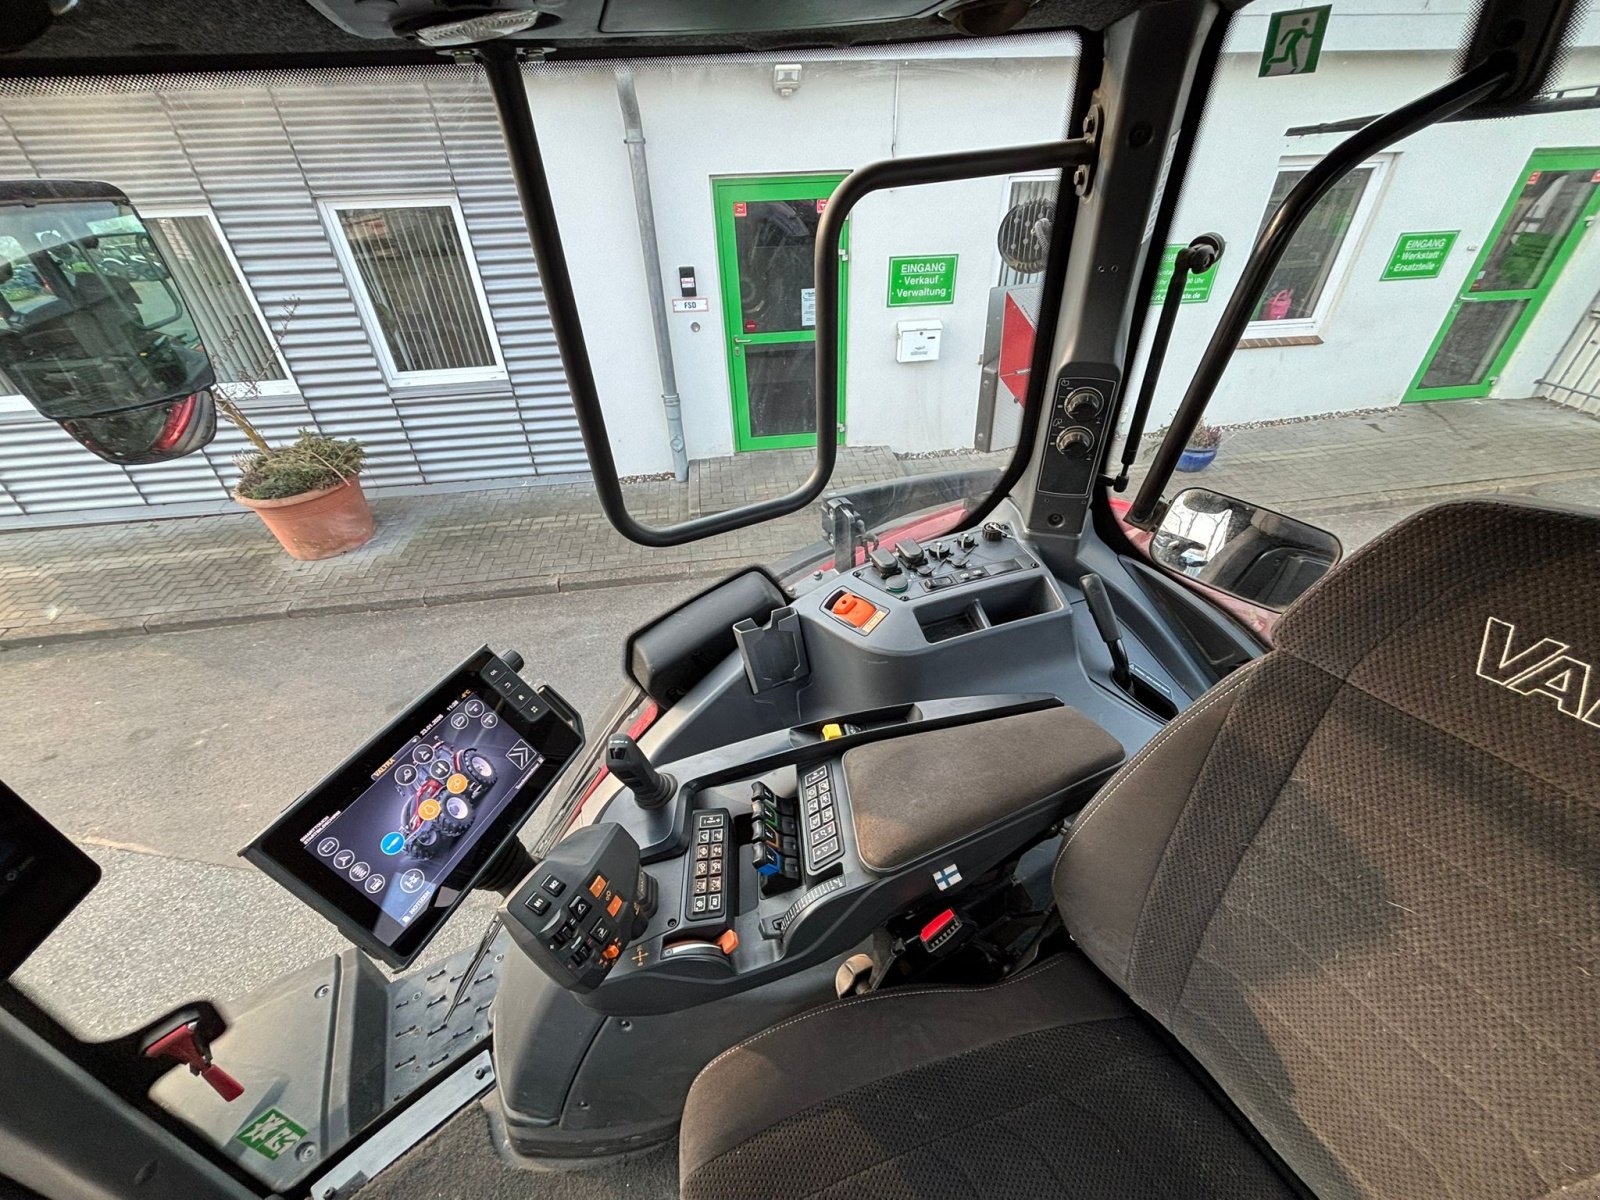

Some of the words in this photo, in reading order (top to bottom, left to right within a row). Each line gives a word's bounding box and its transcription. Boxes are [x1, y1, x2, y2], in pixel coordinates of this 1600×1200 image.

[1405, 238, 1446, 249] EINGANG
[1401, 250, 1440, 260] Werkstatt
[901, 262, 946, 274] EINGANG
[1393, 261, 1435, 272] Ersatzteile
[904, 275, 939, 285] Verkauf
[897, 287, 947, 298] Verwaltung
[373, 757, 396, 779] VALTRA
[549, 880, 559, 890] M2
[533, 897, 544, 907] M1
